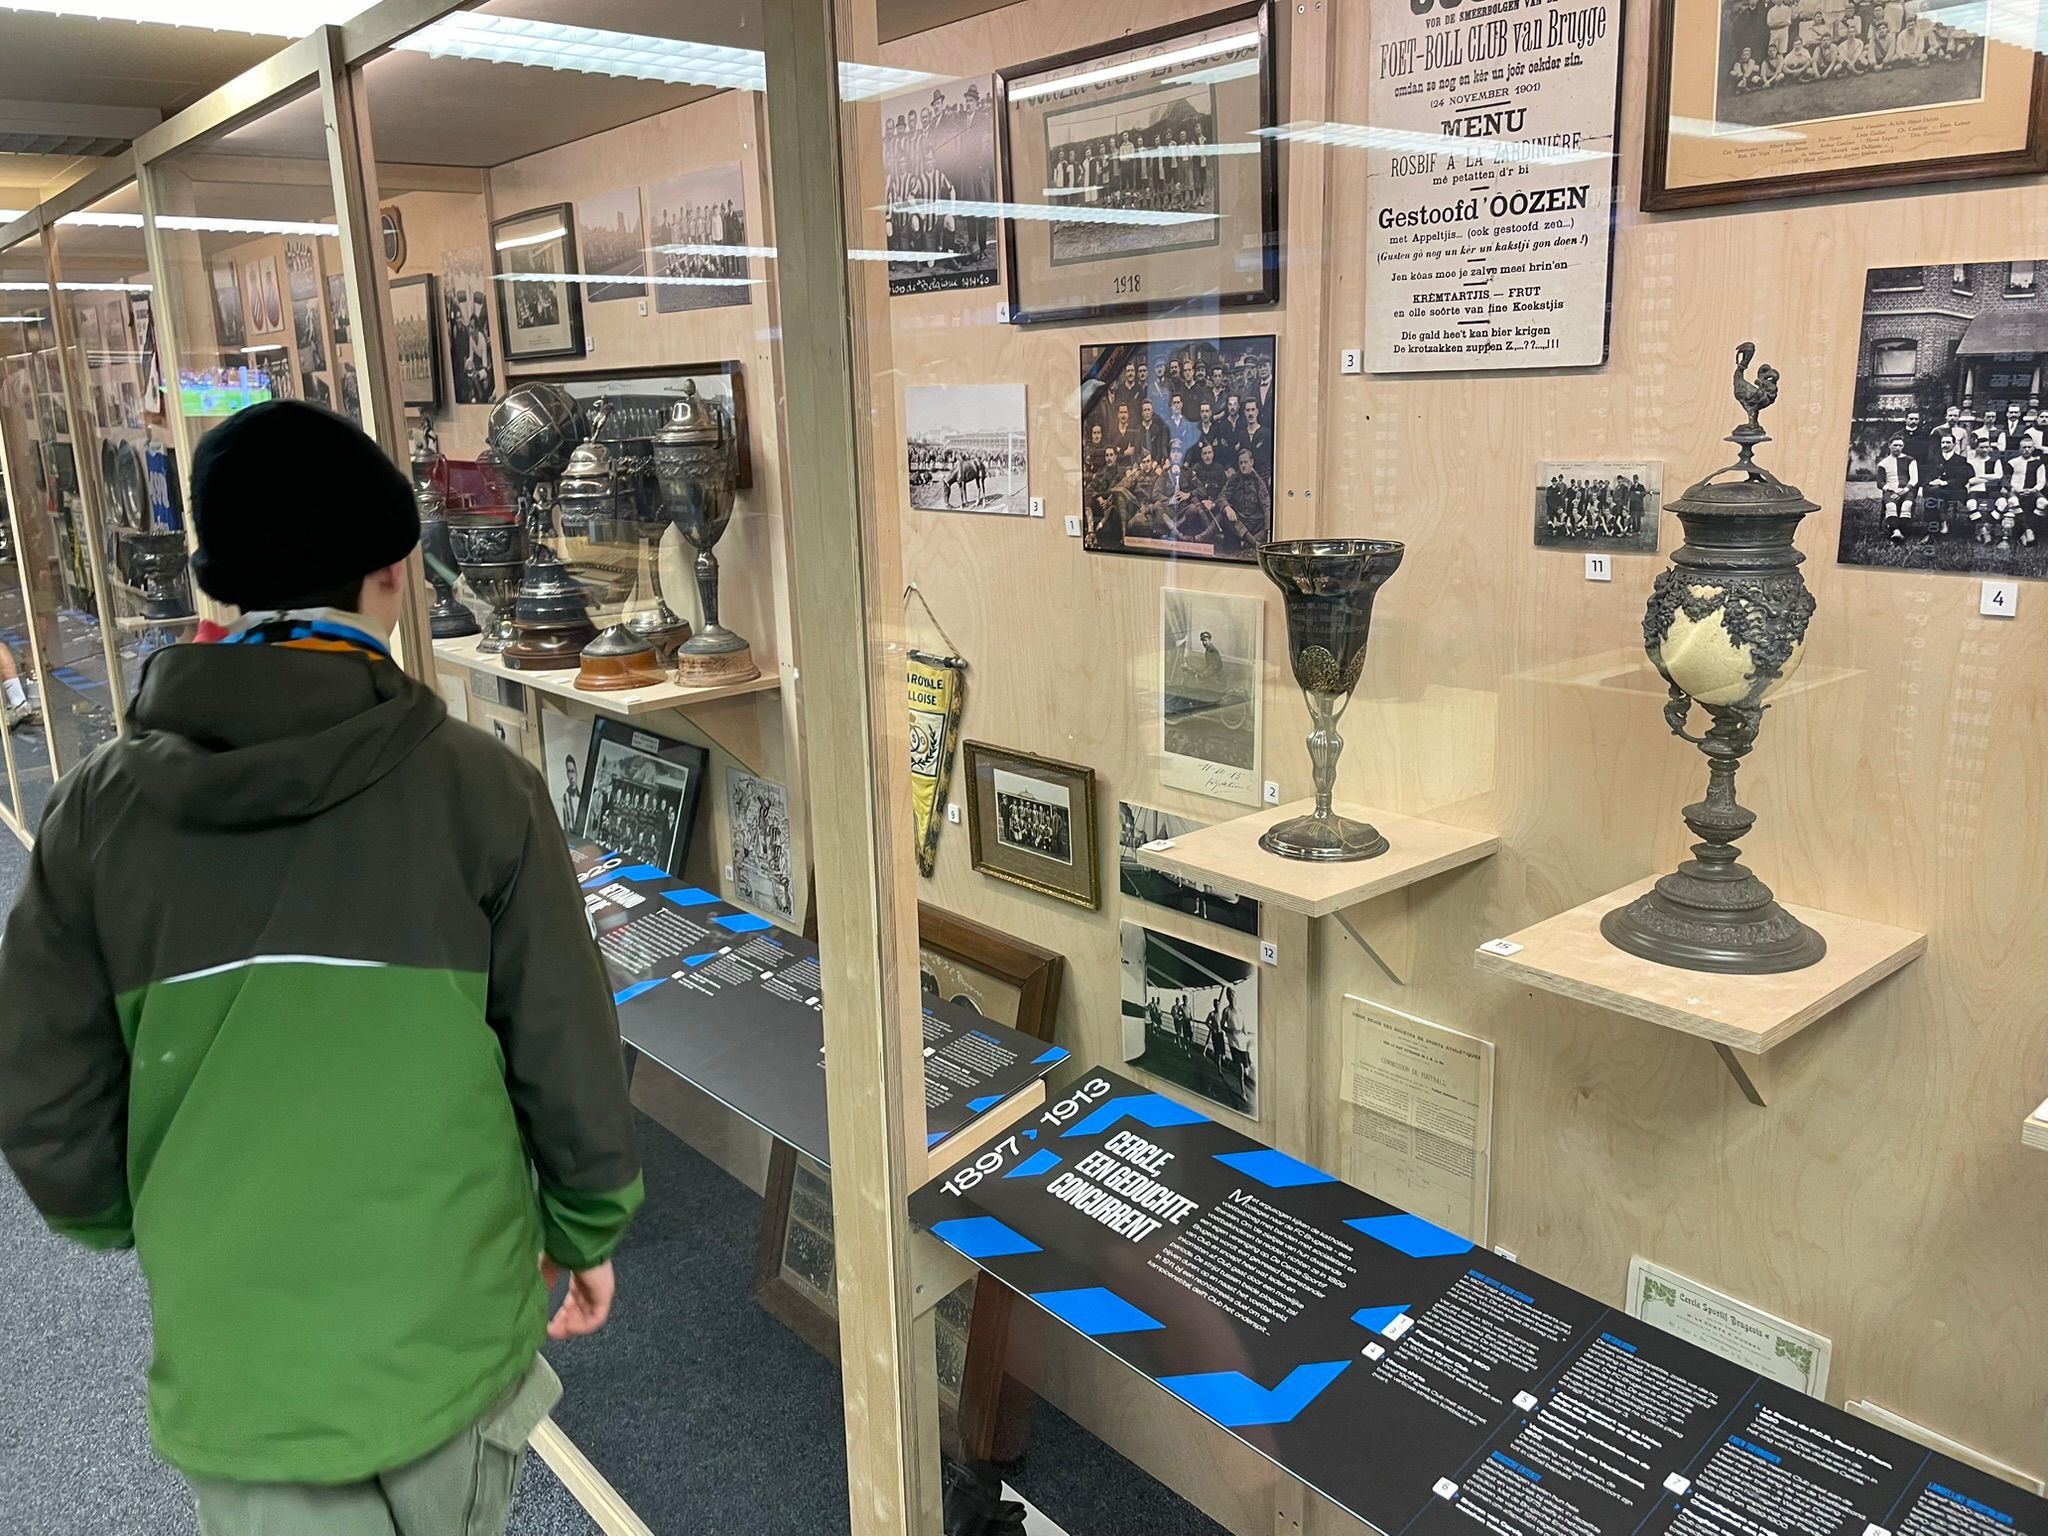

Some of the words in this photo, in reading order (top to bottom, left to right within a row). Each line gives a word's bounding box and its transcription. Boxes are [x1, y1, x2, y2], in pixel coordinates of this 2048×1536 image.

[1425, 17, 1441, 29] VOR
[1445, 14, 1455, 25] DE
[1380, 29, 1463, 79] FOET-BOLL
[1468, 19, 1508, 62] CLUB
[1513, 19, 1542, 54] van
[1547, 6, 1606, 49] Brugge
[1395, 82, 1424, 97] omdan
[1426, 80, 1436, 91] ze
[1439, 77, 1456, 91] nog
[1492, 68, 1504, 80] un
[1564, 52, 1584, 67] zin.
[1430, 98, 1445, 109] (24
[1449, 88, 1509, 106] NOVEMBER
[1514, 82, 1541, 95] 1901)
[1441, 108, 1527, 137] MENU
[1391, 153, 1438, 177] ROSBIF
[1452, 171, 1495, 185] petatten
[1518, 164, 1529, 175] bi
[1379, 198, 1479, 229] Gestoofd
[1390, 235, 1408, 244] met
[1467, 226, 1489, 239] (ook
[1493, 221, 1539, 237] gestoofd
[1426, 250, 1442, 259] nog
[1479, 245, 1492, 253] un
[1532, 240, 1551, 251] gon
[1554, 236, 1577, 246] doen
[1470, 266, 1498, 276] zalve
[1113, 274, 1142, 294] 1918
[1508, 286, 1541, 297] FRUT
[1464, 306, 1483, 314] van
[1401, 331, 1417, 340] Die
[1419, 330, 1440, 342] gald
[1469, 329, 1489, 338] kan
[1491, 327, 1513, 337] bier
[1515, 326, 1551, 337] krigen
[1393, 345, 1406, 353] De
[1408, 343, 1463, 353] krotzakken
[1466, 342, 1502, 354] zuppen
[1347, 354, 1355, 367] 3
[1033, 501, 1039, 511] 3
[1070, 520, 1074, 530] 1
[1591, 560, 1603, 572] 11
[1992, 590, 2004, 606] 4
[910, 674, 944, 690] ROYALE
[1269, 787, 1276, 798] 2
[1264, 946, 1274, 959] 12
[940, 1135, 1021, 1198] 1897
[1039, 1078, 1112, 1127] 1913
[1104, 1130, 1176, 1178] CERCLE,
[1074, 1150, 1121, 1182] EEN
[1103, 1166, 1199, 1225] GEDUCHTE
[1046, 1172, 1163, 1243] CONCURRENT
[1227, 1188, 1261, 1209] Met
[1319, 1232, 1354, 1251] katholieke
[1206, 1212, 1256, 1239] voetbalkinderen
[1287, 1254, 1311, 1269] richten
[1220, 1200, 1261, 1223] voetbalploeg
[1260, 1221, 1274, 1229] met
[1273, 1228, 1298, 1242] banden
[1297, 1240, 1313, 1250] met
[1311, 1247, 1347, 1268] socialisten
[1199, 1218, 1212, 1226] een
[1226, 1233, 1261, 1253] vereniging
[1269, 1255, 1281, 1263] De
[1279, 1261, 1303, 1275] Cercle
[1301, 1272, 1327, 1288] Sportif
[1239, 1220, 1253, 1228] Om
[1283, 1243, 1297, 1251] van
[1296, 1250, 1310, 1258] hun
[1309, 1256, 1342, 1275] dwalende
[1302, 1233, 1334, 1251] Brugeois
[1337, 1251, 1352, 1260] een
[1191, 1223, 1220, 1240] Brugeois
[1218, 1238, 1238, 1250] wordt
[1237, 1249, 1250, 1257] een
[1248, 1255, 1280, 1274] gevreesd
[1278, 1271, 1325, 1299] tegenstander
[1196, 1235, 1212, 1245] Club
[1241, 1260, 1256, 1270] heel
[1255, 1268, 1269, 1277] wat
[1267, 1275, 1287, 1287] leden
